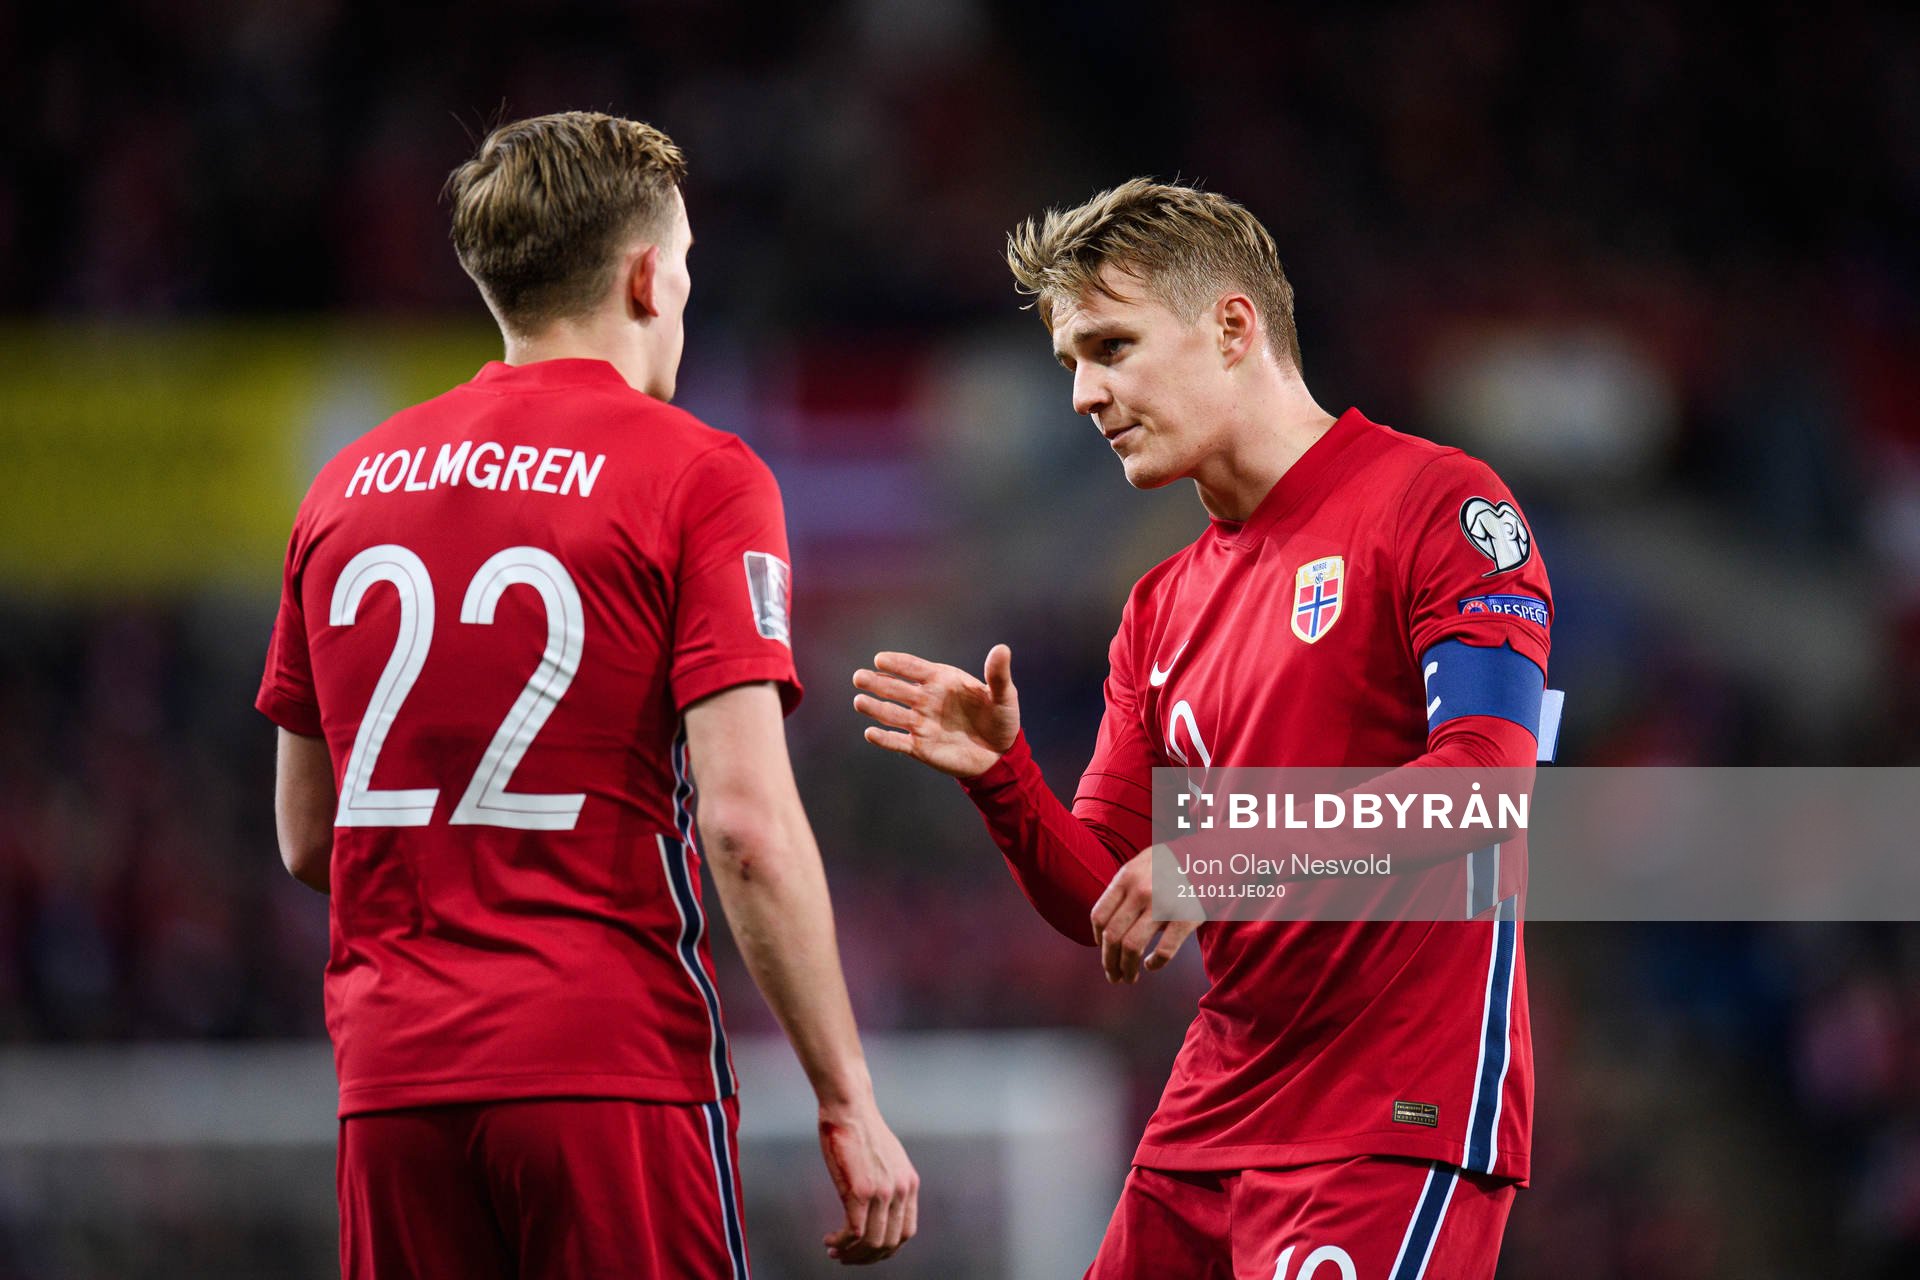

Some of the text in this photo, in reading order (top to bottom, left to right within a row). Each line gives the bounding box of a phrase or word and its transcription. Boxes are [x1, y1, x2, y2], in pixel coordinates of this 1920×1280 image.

[344, 440, 606, 498] HOLMGREN
[1492, 603, 1548, 626] RESPECT
[329, 544, 586, 831] 22
